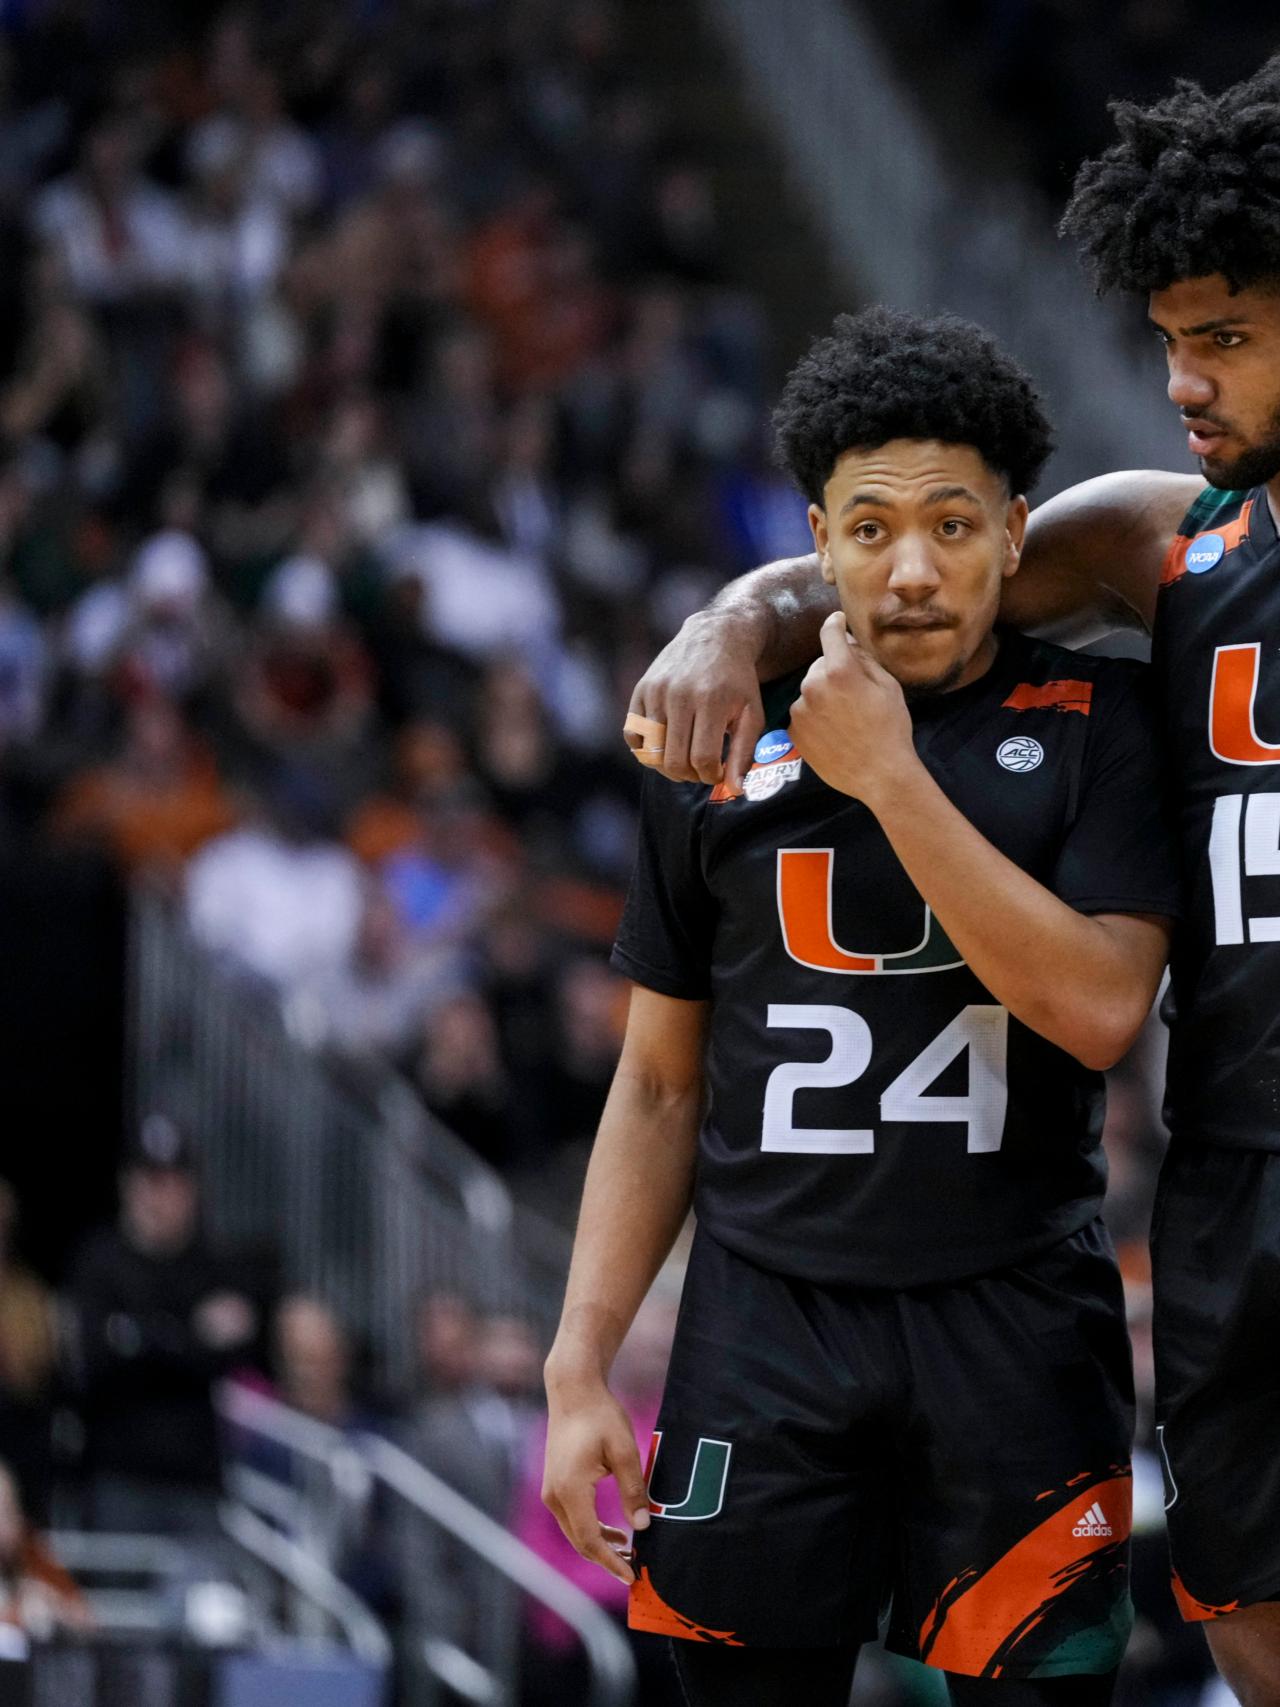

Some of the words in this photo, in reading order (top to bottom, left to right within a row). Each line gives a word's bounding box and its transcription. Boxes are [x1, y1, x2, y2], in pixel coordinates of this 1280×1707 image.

[1003, 748, 1040, 757] ACC
[777, 847, 967, 976] U
[760, 1003, 1009, 1154] 24
[1072, 1525, 1113, 1538] adidas
